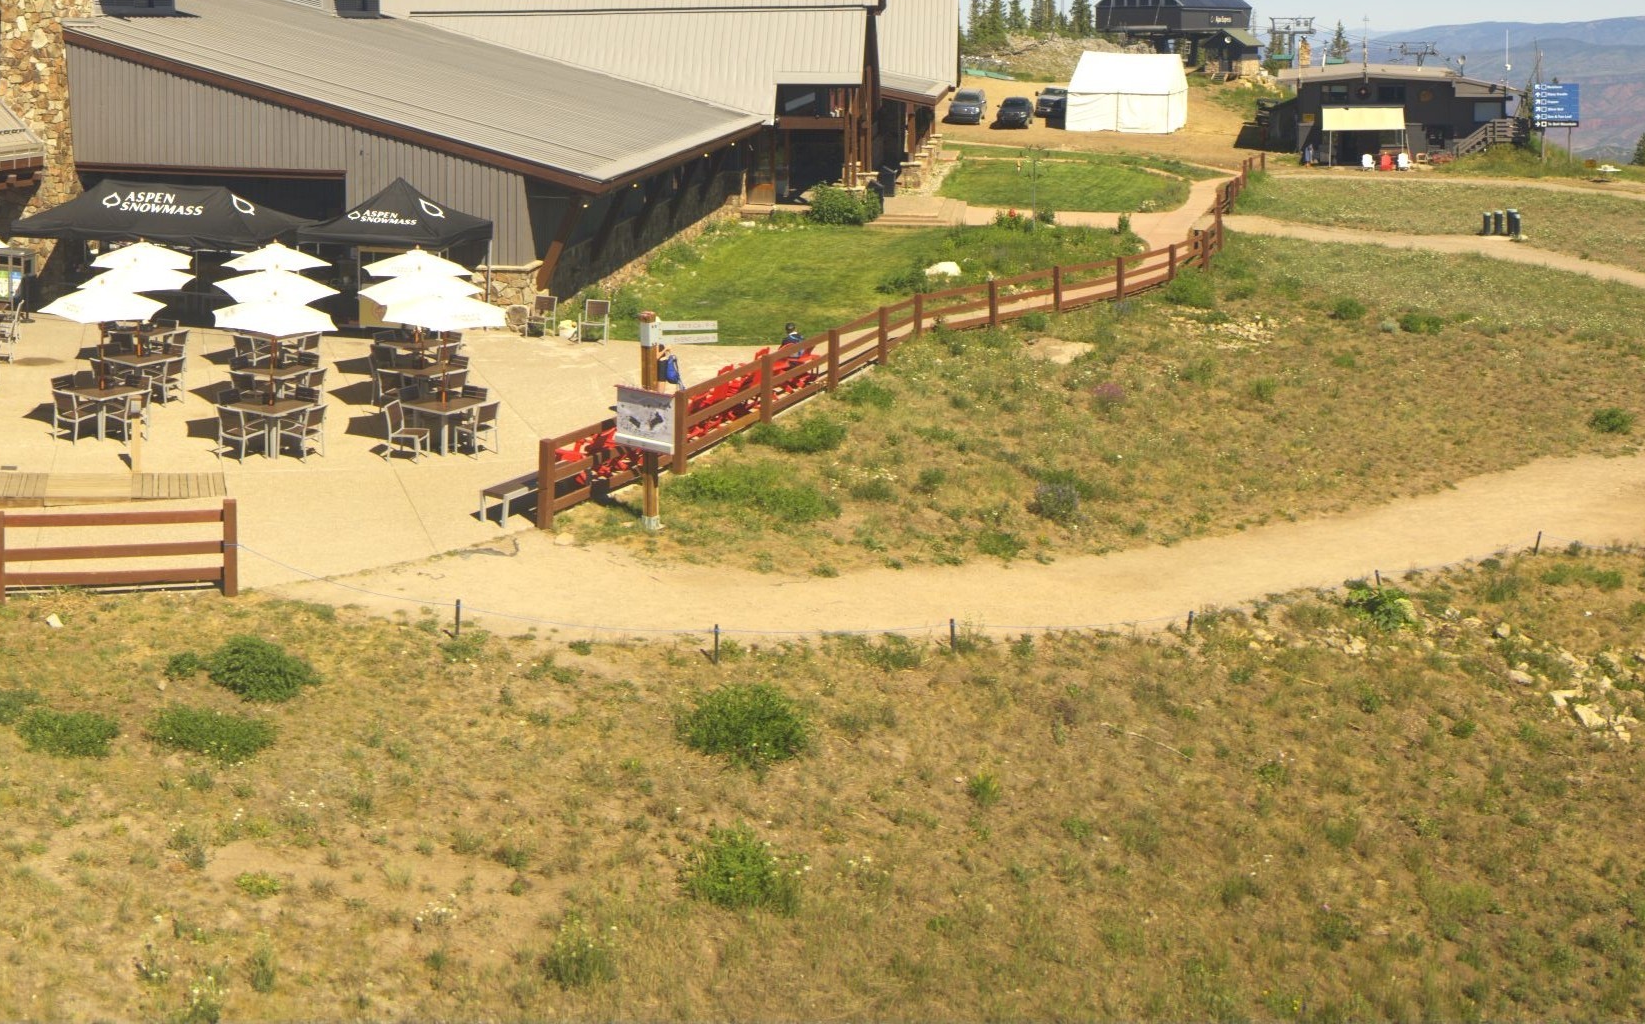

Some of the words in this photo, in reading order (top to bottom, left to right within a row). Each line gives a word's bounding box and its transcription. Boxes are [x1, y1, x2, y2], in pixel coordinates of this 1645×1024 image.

[125, 191, 176, 205] ASPEN
[120, 201, 204, 216] SNOWMASS
[362, 209, 398, 219] ASPEN
[360, 215, 417, 226] SNOWMASS
